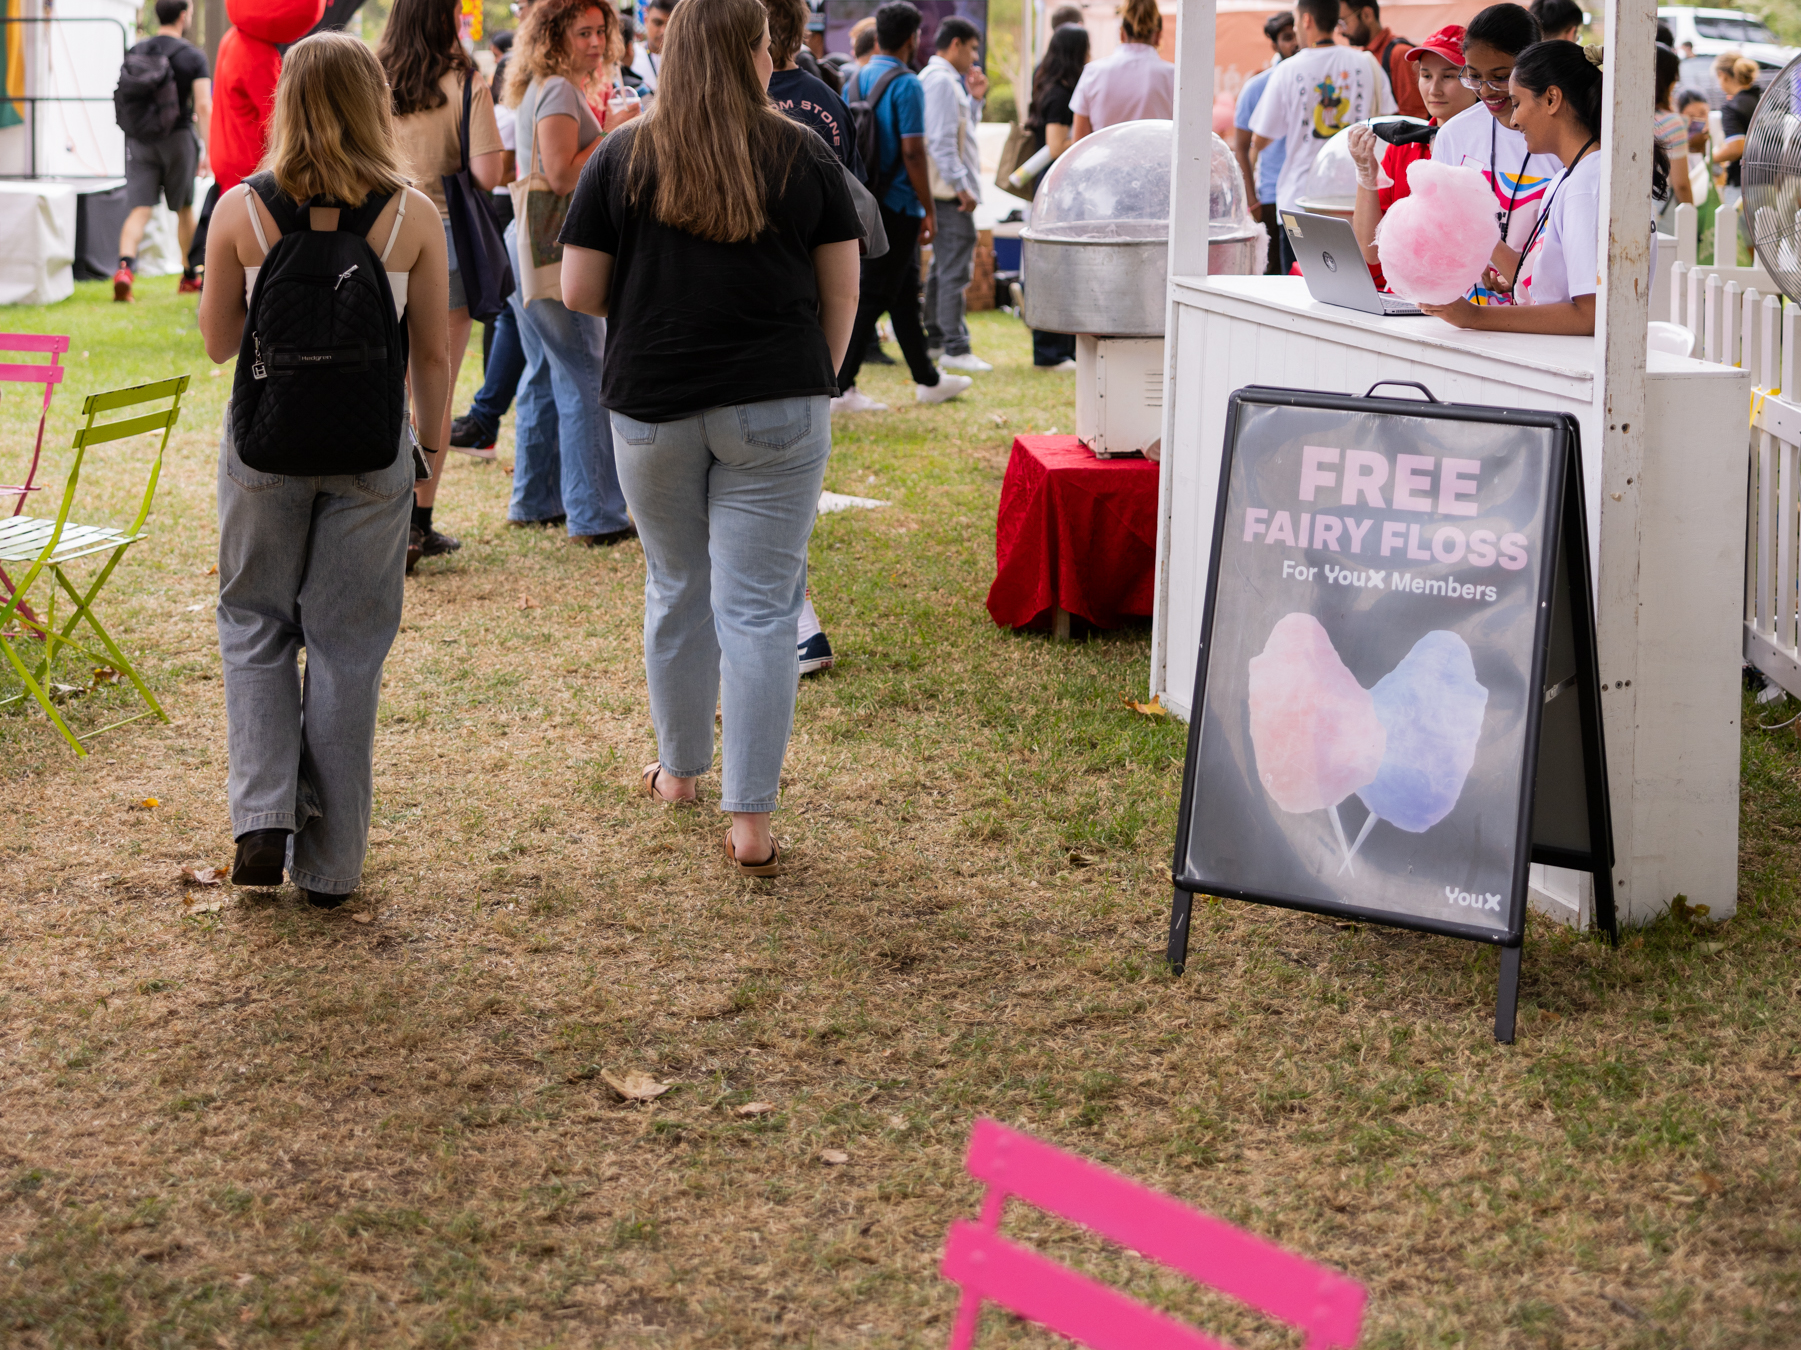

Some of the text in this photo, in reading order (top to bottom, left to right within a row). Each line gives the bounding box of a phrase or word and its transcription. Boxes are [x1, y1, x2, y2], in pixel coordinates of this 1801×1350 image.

[800, 100, 841, 147] STONE
[1298, 445, 1482, 517] FREE
[1242, 507, 1529, 571] FAIRY FLOSS
[1282, 559, 1498, 603] For YouX Members
[1445, 885, 1502, 912] YouX
